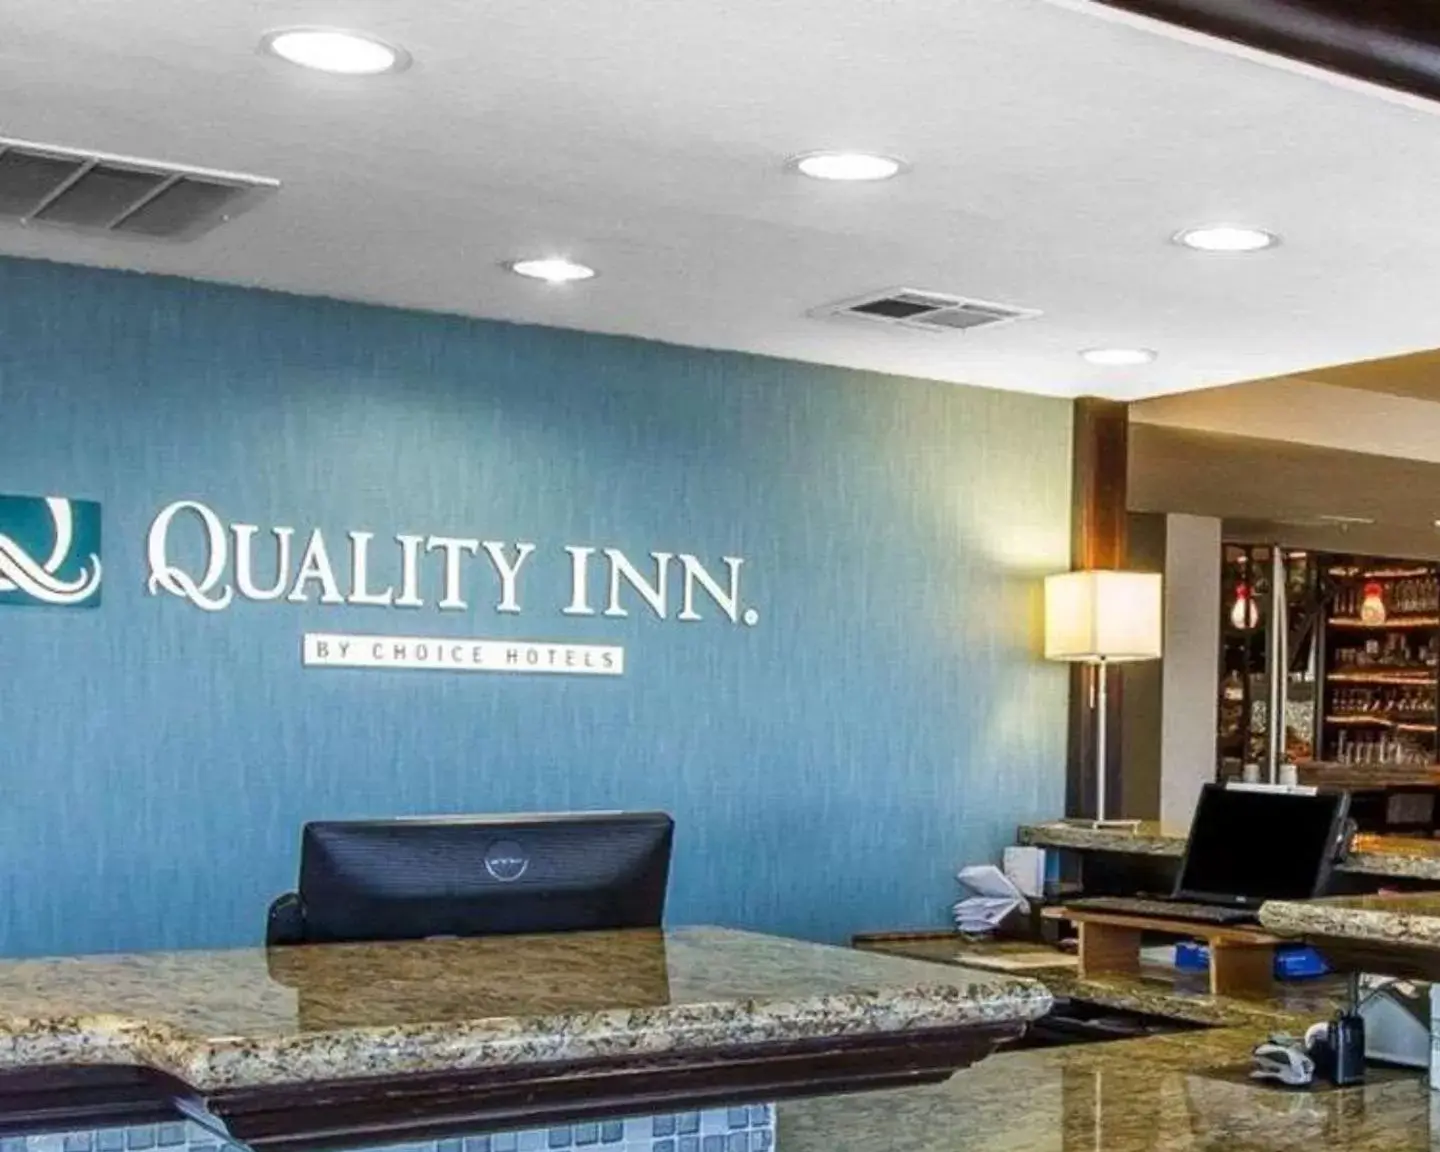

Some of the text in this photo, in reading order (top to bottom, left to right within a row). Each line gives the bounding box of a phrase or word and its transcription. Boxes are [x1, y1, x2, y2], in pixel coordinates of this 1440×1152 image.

[147, 500, 538, 613] QUALITY
[316, 640, 615, 668] BY CHOICE HOTELS
